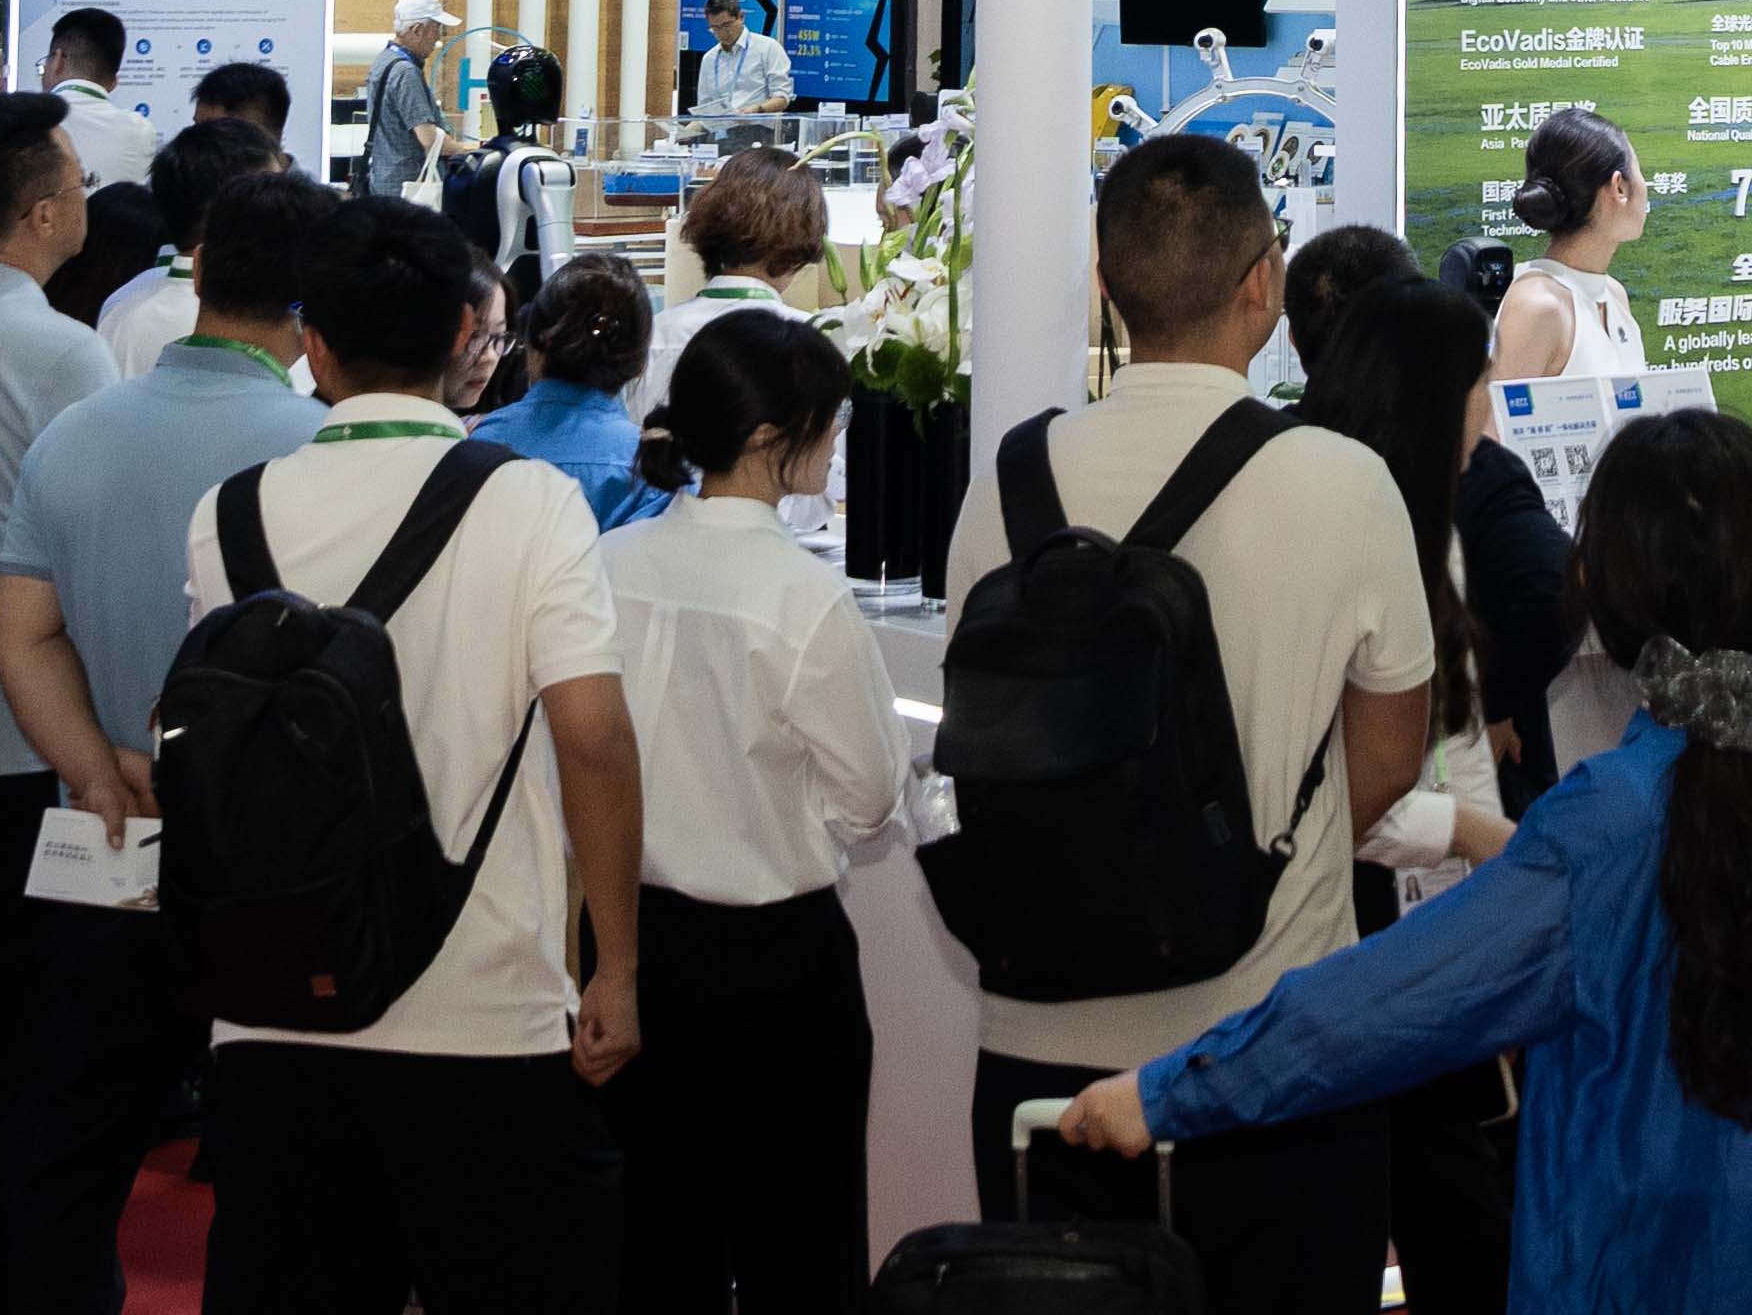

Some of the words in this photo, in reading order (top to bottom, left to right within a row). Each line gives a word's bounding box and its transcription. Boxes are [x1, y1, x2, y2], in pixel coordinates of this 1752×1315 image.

[1460, 27, 1645, 53] EcoVadis金牌认证
[1460, 58, 1511, 71] EcoVadis
[1513, 57, 1538, 70] Gold
[1539, 56, 1572, 69] Medal
[1573, 55, 1619, 69] Certified
[1481, 138, 1504, 150] Asia
[1688, 128, 1729, 141] National
[1731, 169, 1752, 218] 7
[1664, 335, 1676, 351] A
[1678, 331, 1735, 354] globally
